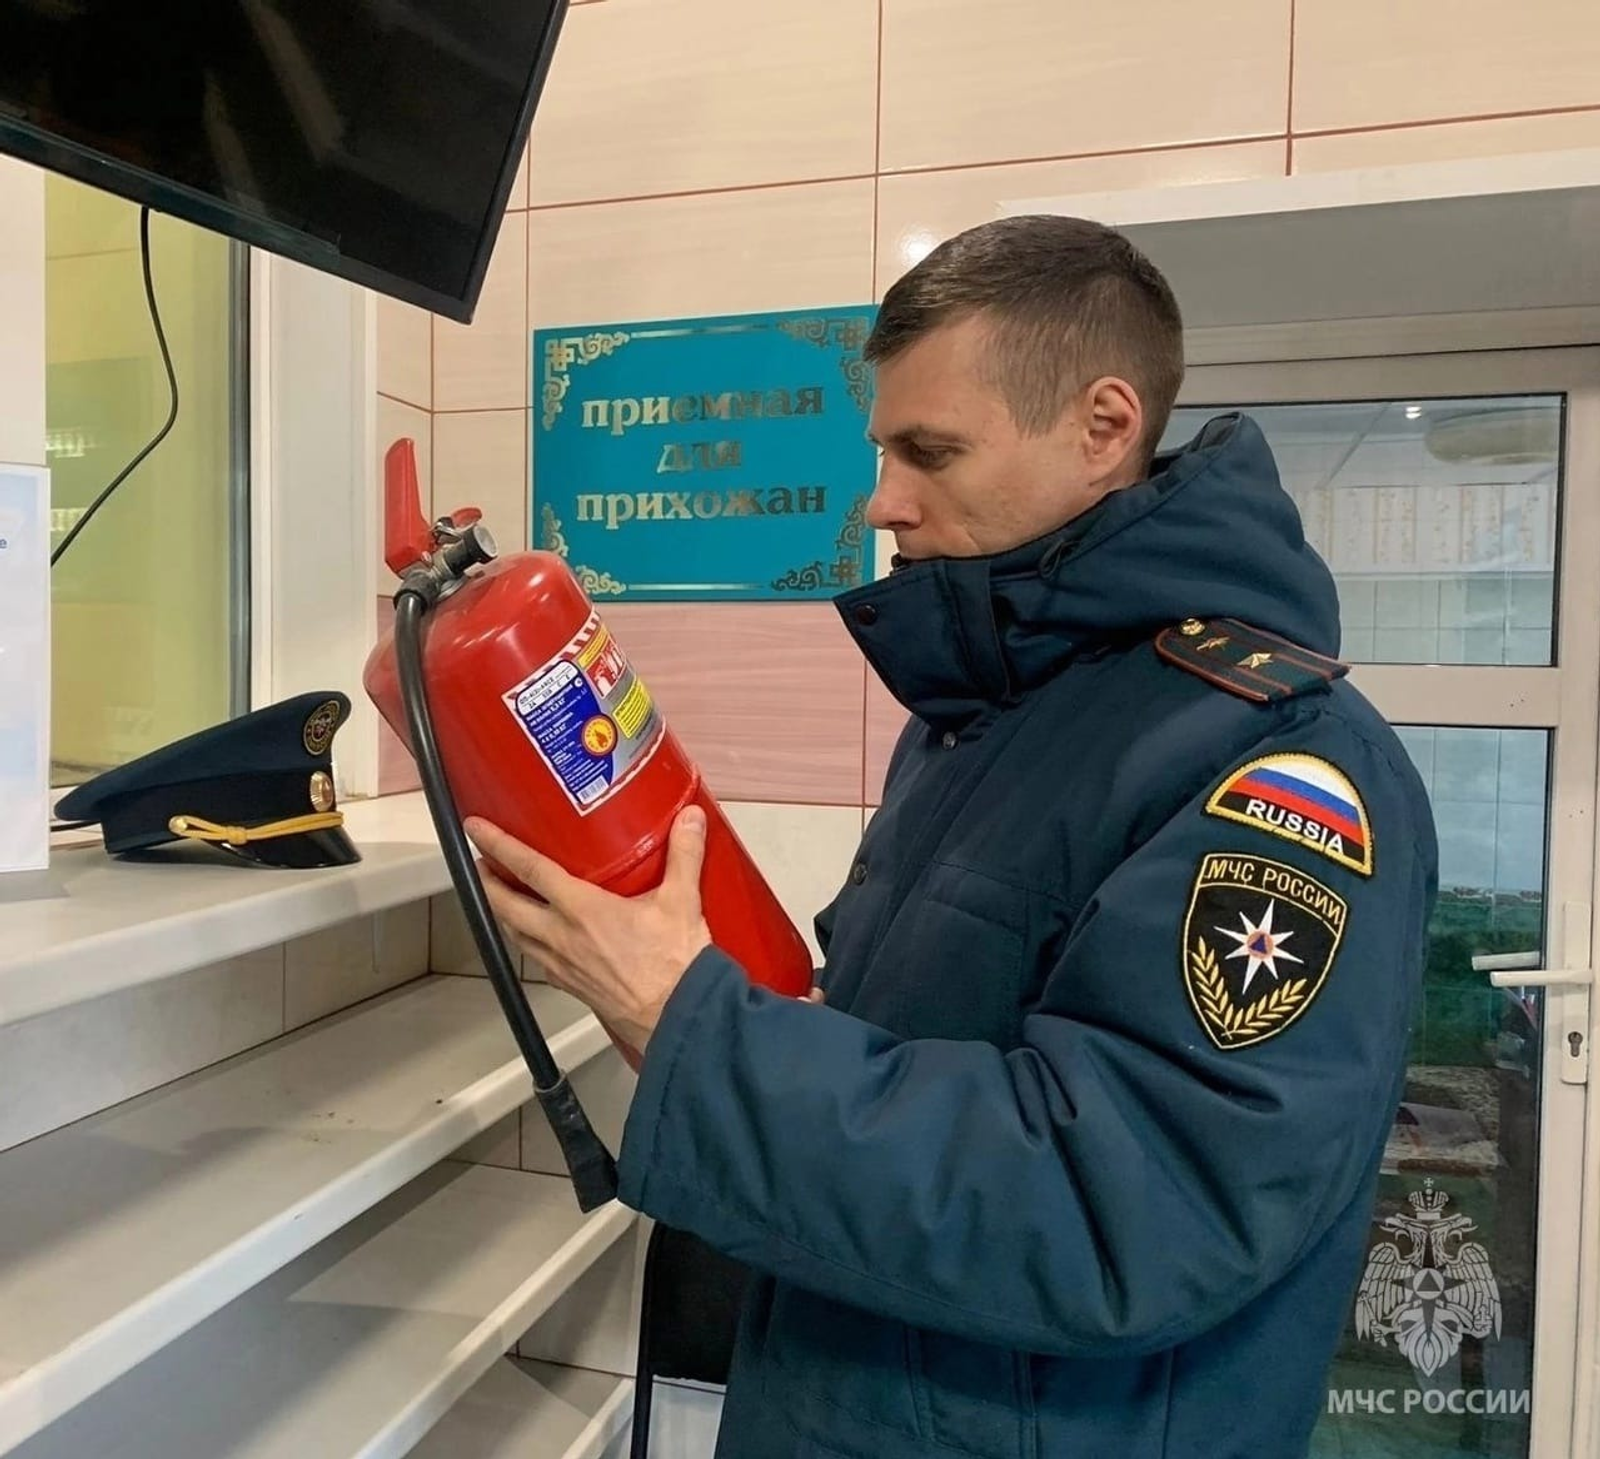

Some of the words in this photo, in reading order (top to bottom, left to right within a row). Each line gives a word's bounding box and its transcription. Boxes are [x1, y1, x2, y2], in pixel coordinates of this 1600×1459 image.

[581, 386, 824, 435] приемная
[656, 440, 742, 474] для
[576, 486, 827, 530] прихожан
[1245, 798, 1344, 854] RUSSIA
[1206, 859, 1255, 882] МЧС
[1262, 867, 1341, 925] РОССИИ
